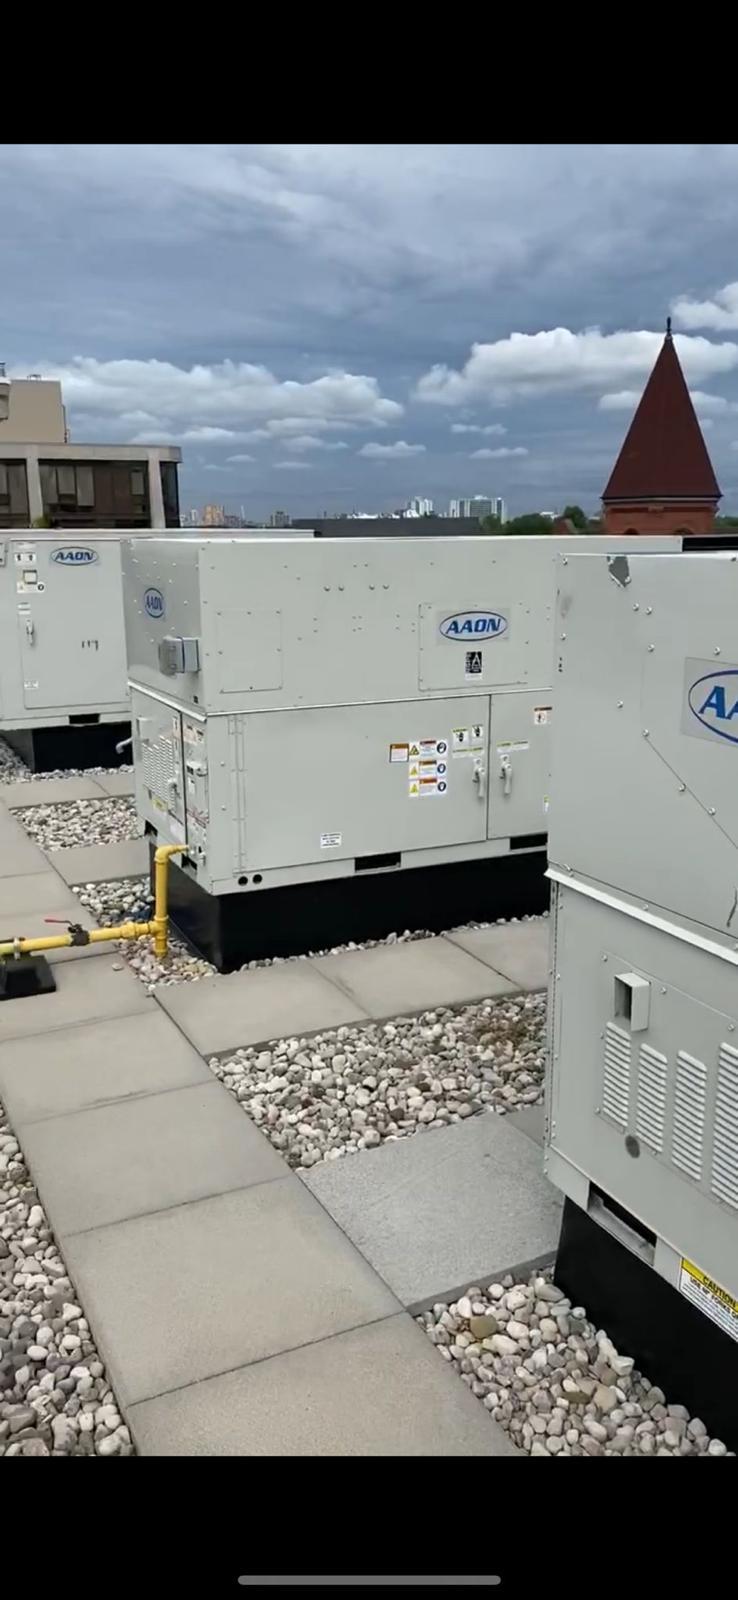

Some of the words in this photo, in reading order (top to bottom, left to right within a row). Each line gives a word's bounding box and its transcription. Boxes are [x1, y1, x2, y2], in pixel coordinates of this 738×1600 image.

[55, 551, 94, 561] AAON
[445, 618, 501, 634] AAON
[703, 1276, 736, 1307] CAUTION
